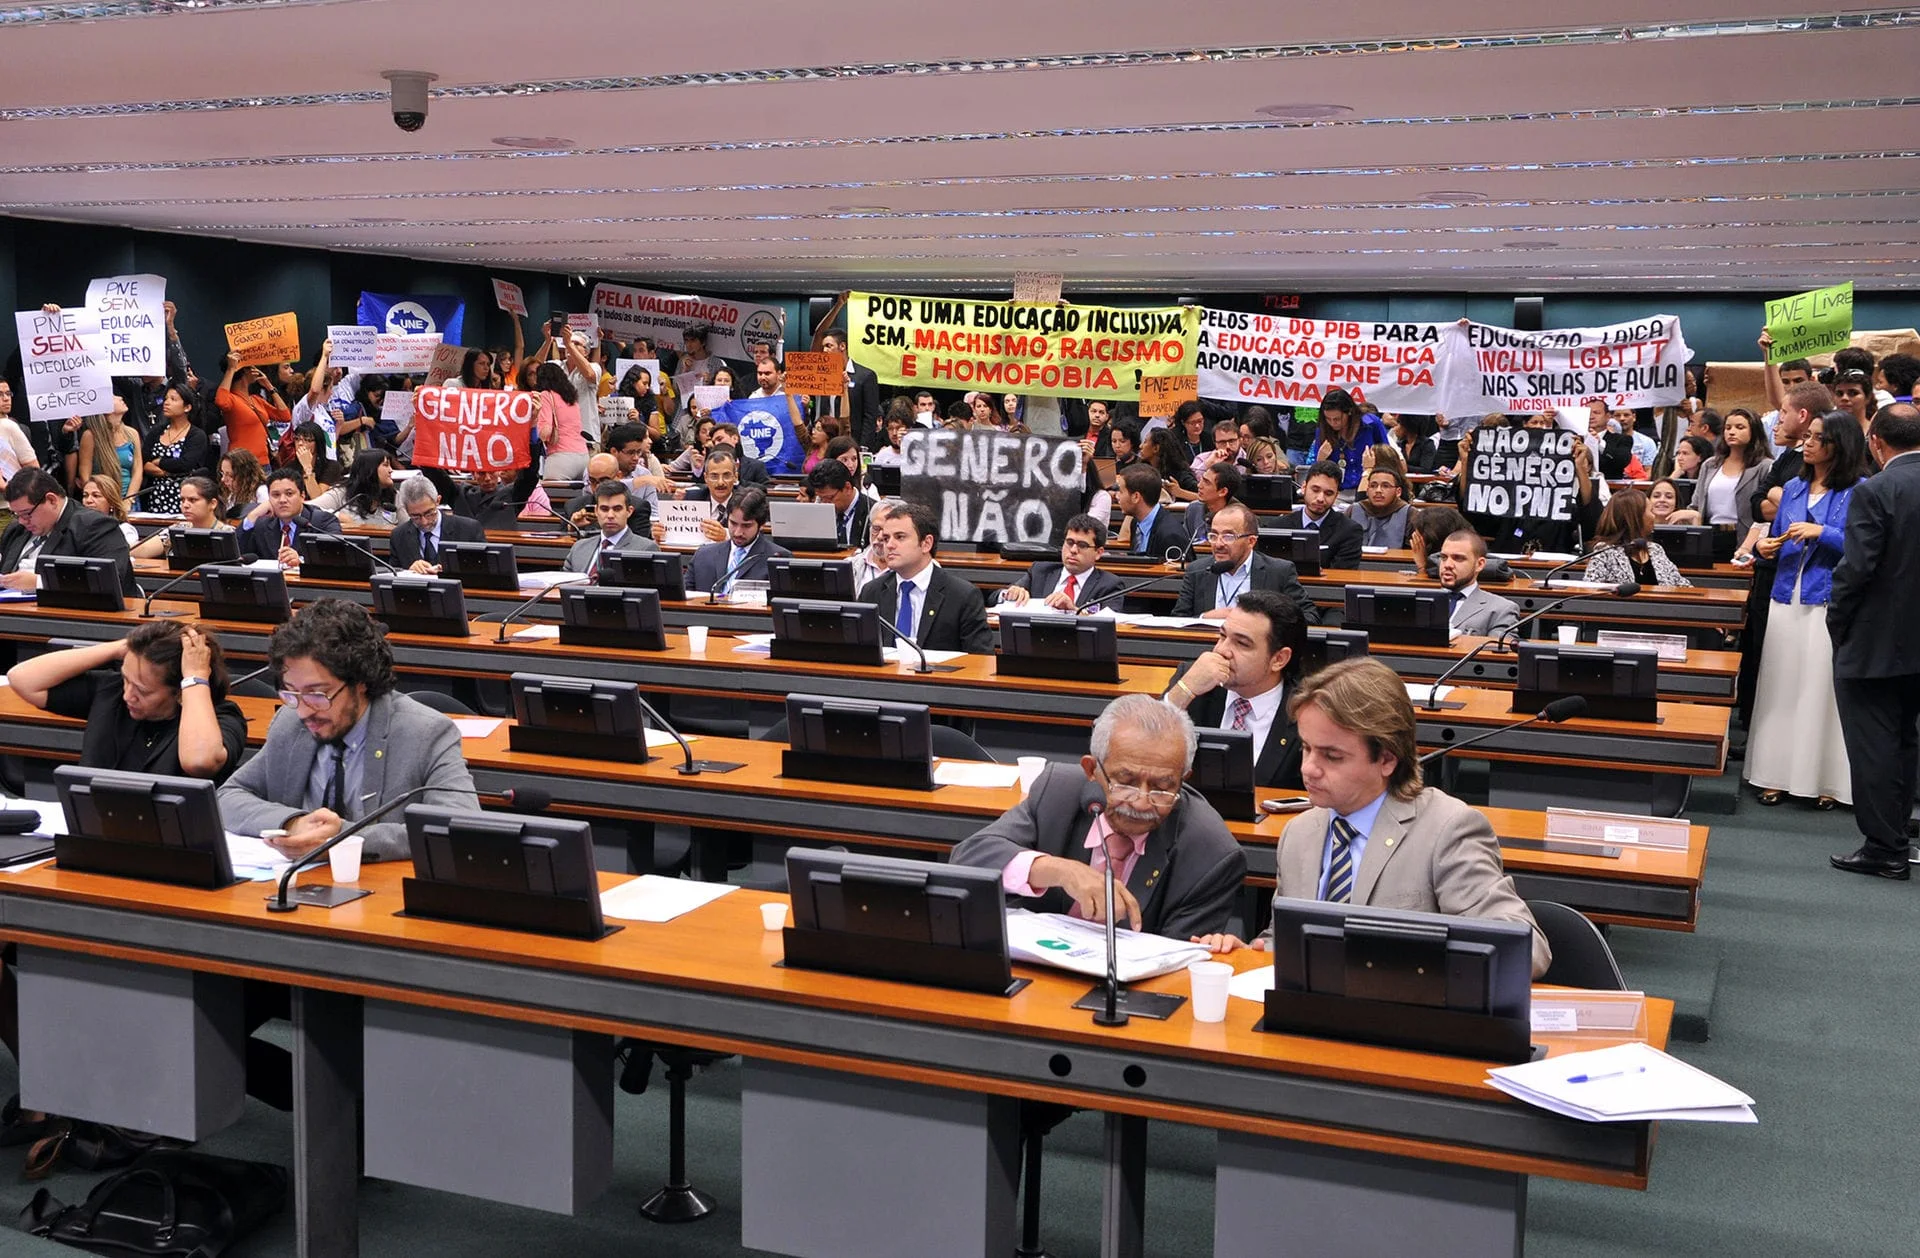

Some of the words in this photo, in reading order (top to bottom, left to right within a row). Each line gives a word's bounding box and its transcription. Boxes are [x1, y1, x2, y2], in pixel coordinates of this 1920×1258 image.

[105, 281, 138, 296] PNE
[98, 297, 139, 313] SEM
[596, 290, 632, 309] PELA
[638, 295, 738, 326] VALORIZAÇÃO
[604, 309, 632, 321] todos/as
[633, 313, 651, 325] os/as
[868, 296, 912, 321] POR
[920, 301, 965, 325] UMA
[973, 305, 1080, 335] EDUCAÇÃO
[1087, 310, 1188, 336] INCLUSIVA,
[1770, 297, 1807, 326] PNE
[33, 314, 76, 334] PNE
[101, 314, 154, 330] EOLOGIA
[400, 319, 424, 329] UNE
[744, 329, 778, 341] EDUCAÇÃO
[1198, 309, 1249, 331] PELOS
[1289, 319, 1315, 336] DO
[1324, 320, 1361, 339] PIB
[1373, 324, 1439, 342] PARA
[1602, 320, 1664, 344] LAICA
[1792, 325, 1807, 337] DO
[32, 334, 84, 356] SEM
[112, 333, 131, 345] DE
[862, 324, 910, 350] SEM,
[914, 328, 1054, 361] MACHISMO,
[1060, 337, 1184, 363] RACISMO
[1197, 330, 1209, 347] A
[1217, 332, 1325, 359] EDUCAÇÃO
[1336, 341, 1435, 364] PÚBLICA
[30, 355, 95, 375] IDEOLOGIA
[105, 346, 151, 363] NERO
[1477, 350, 1543, 373] INCLUI
[1569, 339, 1669, 370] LGBTTT
[901, 354, 917, 377] E
[932, 357, 1118, 390] HOMOFOBIA
[1196, 351, 1294, 377] APOIAMOS
[1301, 362, 1318, 380] O
[1329, 364, 1380, 384] PNE
[1397, 367, 1434, 387] DA
[1482, 374, 1518, 397] NAS
[1527, 372, 1586, 397] SALAS
[1594, 370, 1618, 393] DE
[1626, 364, 1677, 391] AULA
[60, 376, 80, 389] DE
[1145, 377, 1171, 393] PNE
[1239, 375, 1366, 403] CÂMAA
[36, 389, 97, 411] GÊNERO
[418, 387, 532, 426] GÊNERO
[750, 428, 772, 438] UNE
[1477, 426, 1530, 453] NÃO
[1540, 432, 1574, 456] AO
[438, 425, 513, 469] NÃO
[901, 431, 1083, 490] GENERO
[1467, 483, 1510, 516] NO
[1514, 485, 1573, 520] PNE
[941, 489, 1052, 544] NÃO
